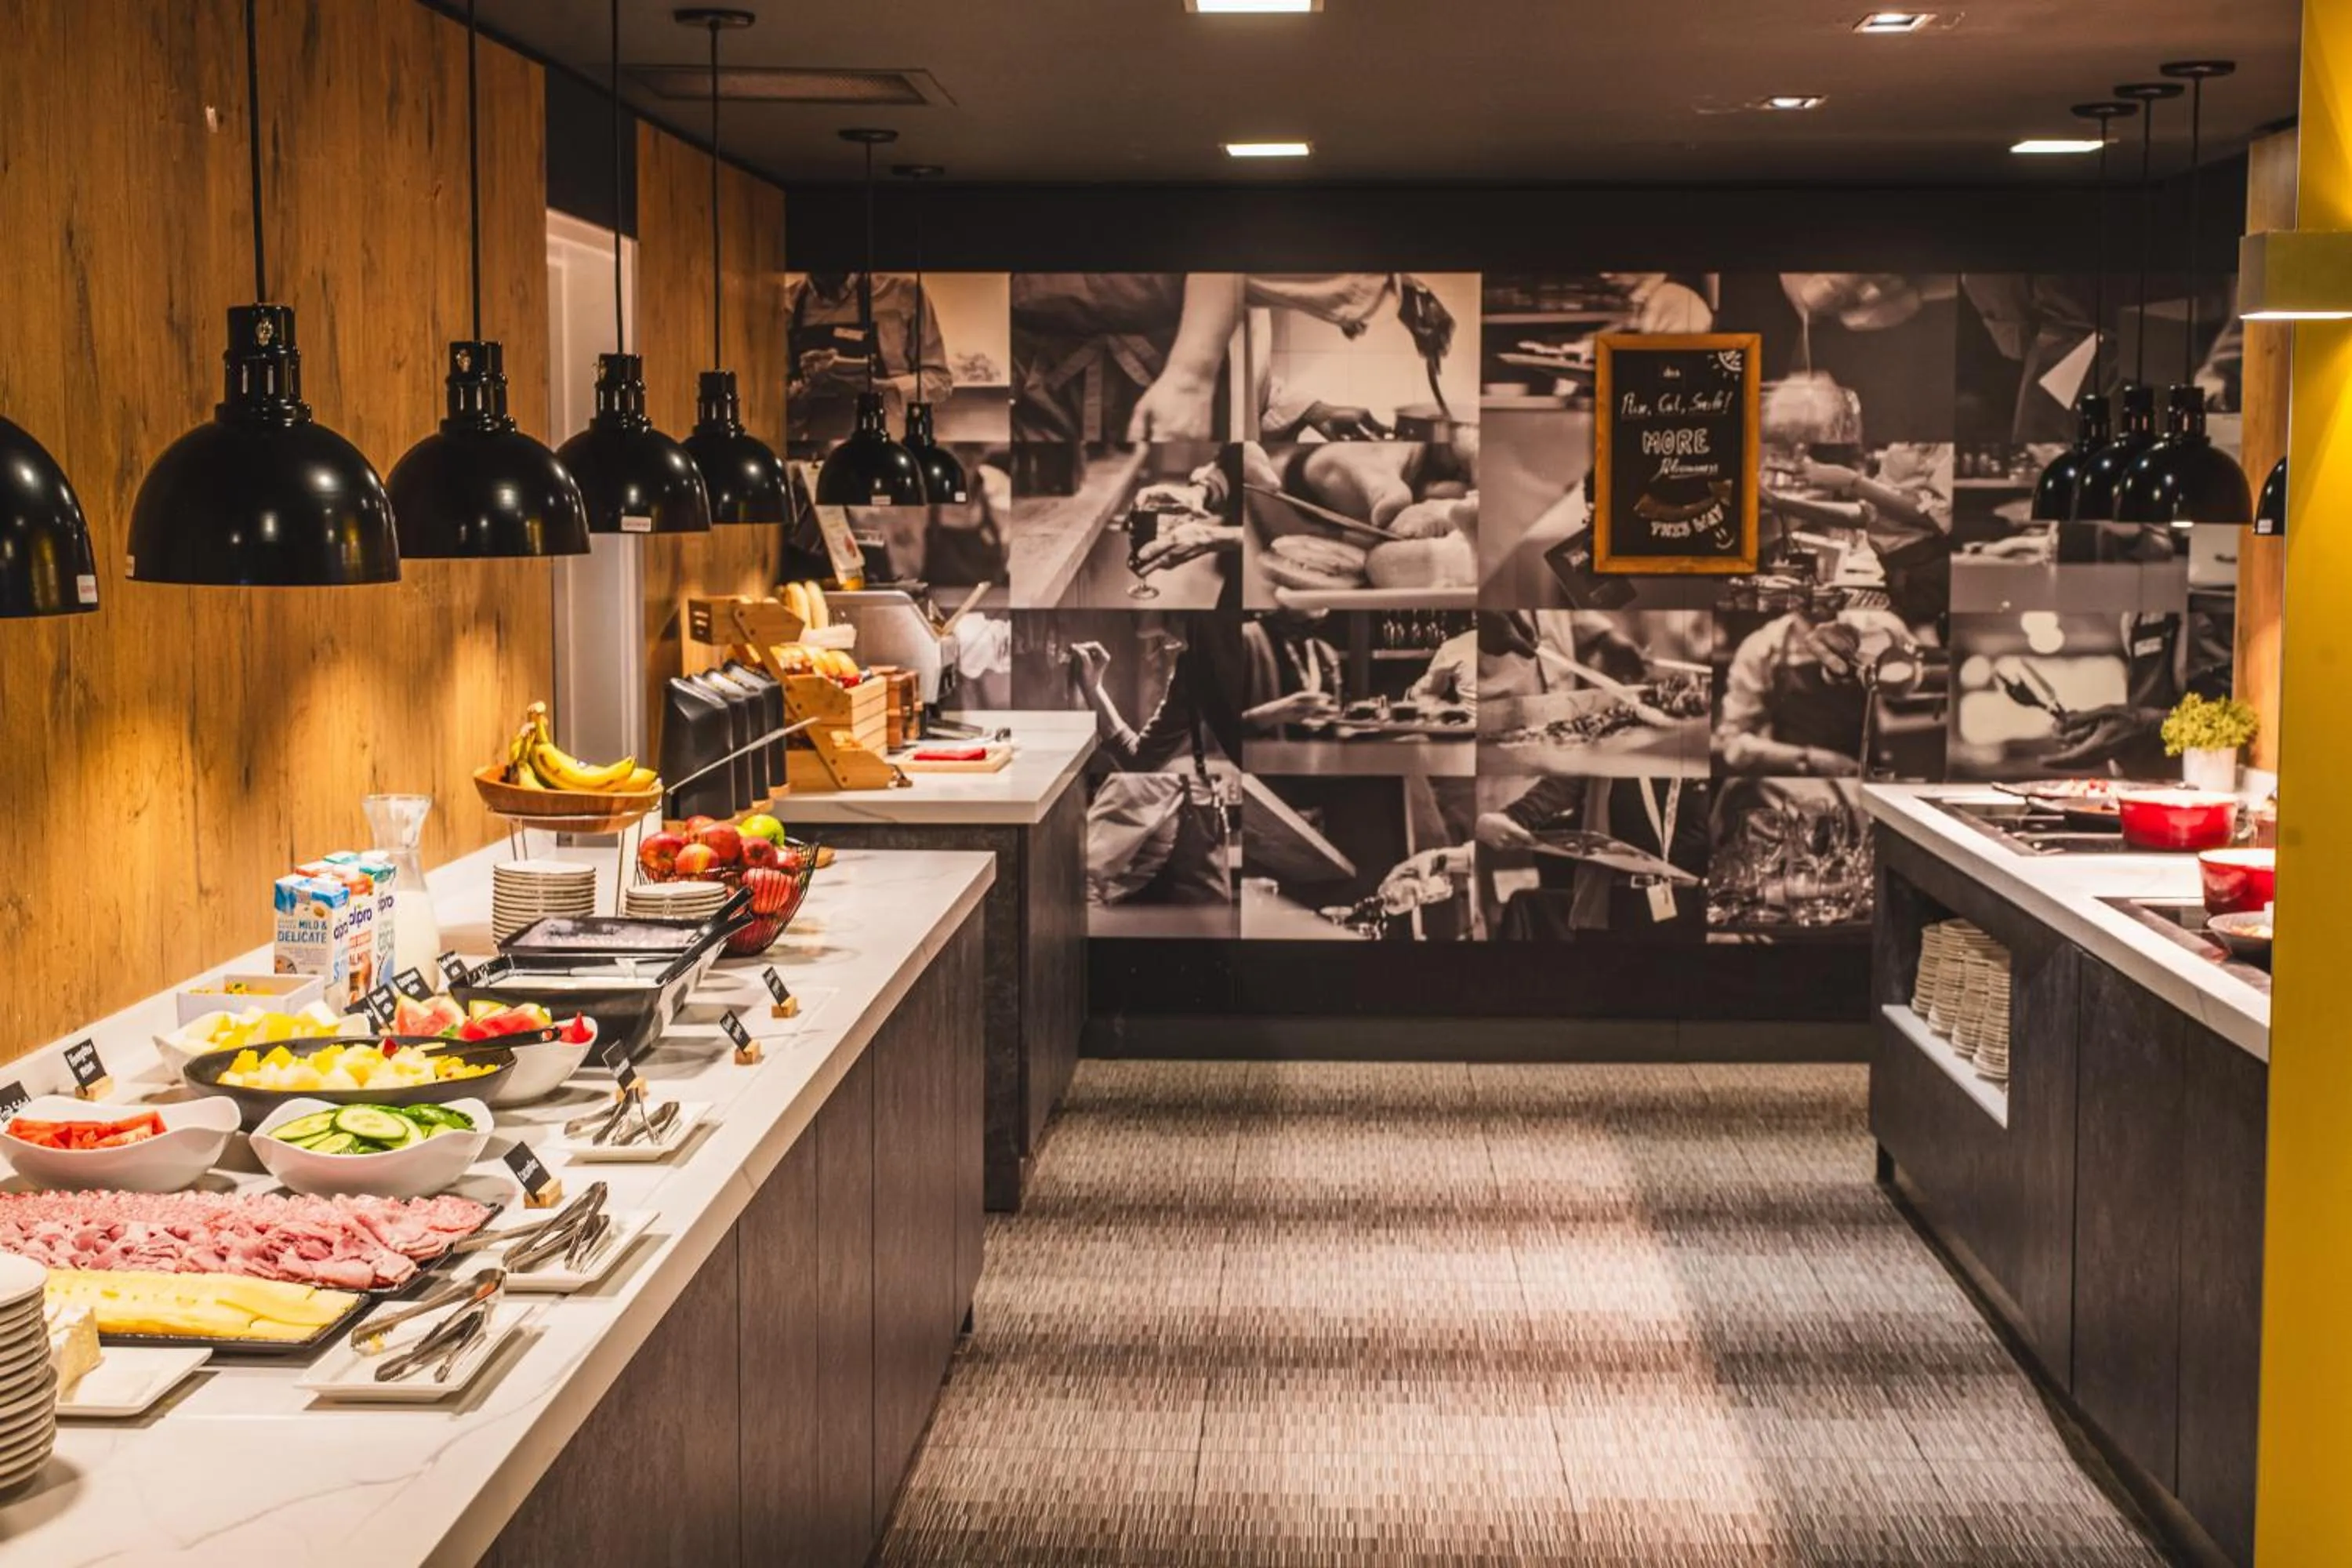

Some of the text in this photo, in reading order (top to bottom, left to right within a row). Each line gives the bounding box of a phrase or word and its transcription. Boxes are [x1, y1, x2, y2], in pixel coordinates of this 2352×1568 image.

[1642, 427, 1711, 456] MORE
[299, 920, 319, 930] MILD
[349, 904, 372, 928] alpro
[278, 931, 327, 944] DELICATE
